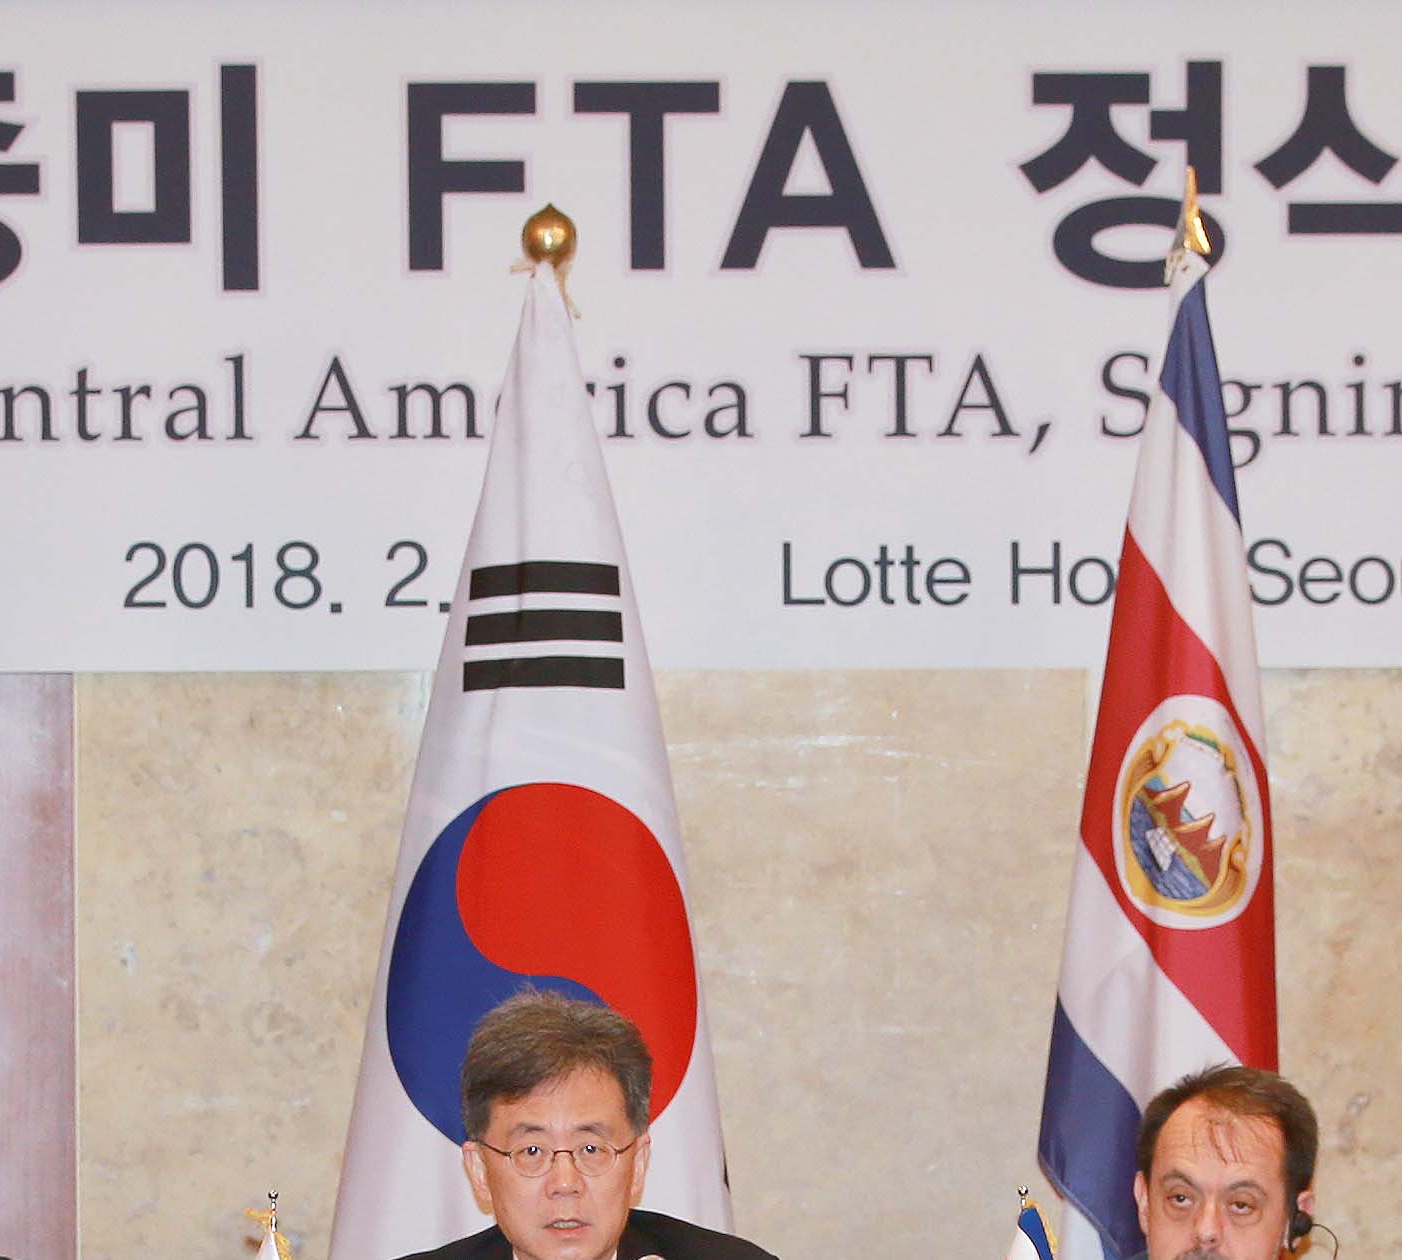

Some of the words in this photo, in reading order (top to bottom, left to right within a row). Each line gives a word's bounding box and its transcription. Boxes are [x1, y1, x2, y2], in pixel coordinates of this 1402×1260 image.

[407, 81, 897, 271] FTA
[293, 355, 754, 441] Amica
[798, 353, 1051, 455] FTA,
[123, 540, 343, 614] 2018.
[782, 541, 972, 608] Lotte
